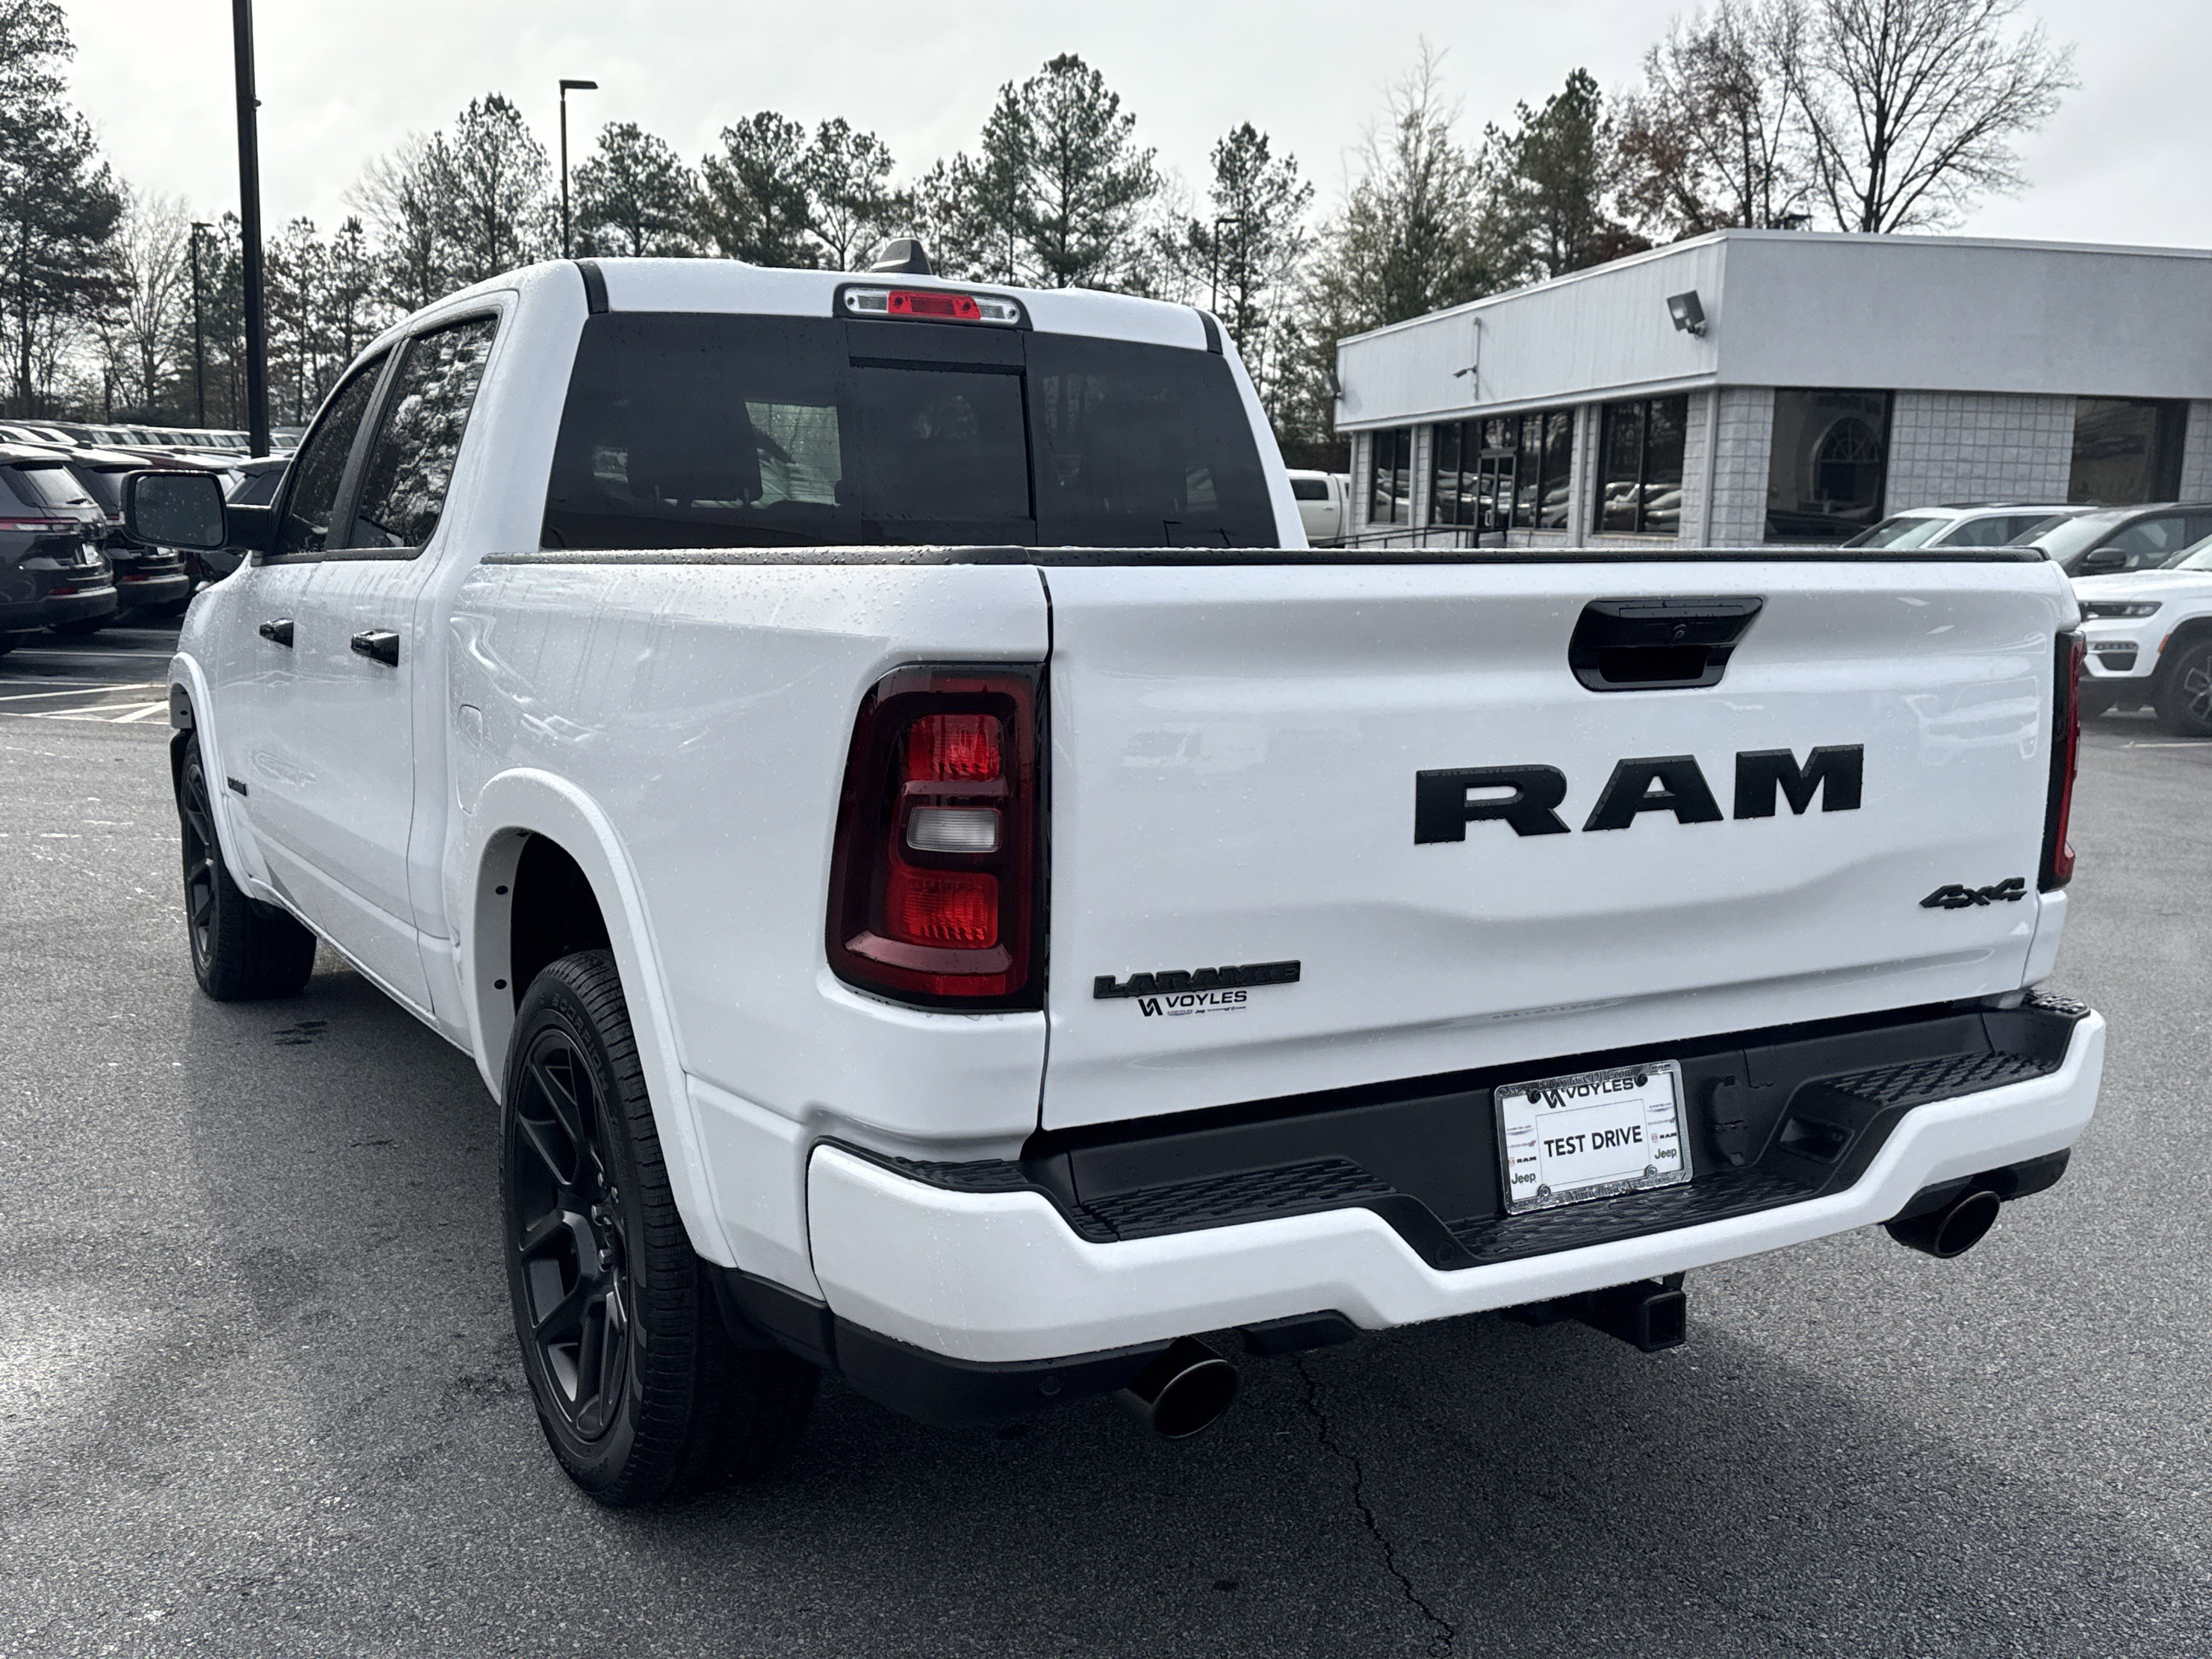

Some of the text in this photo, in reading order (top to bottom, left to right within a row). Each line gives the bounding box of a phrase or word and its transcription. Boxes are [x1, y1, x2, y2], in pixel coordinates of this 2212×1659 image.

[1414, 744, 1864, 845] RAM
[1919, 877, 2027, 910] 4x4
[1093, 960, 1301, 998] LARAMIE
[1165, 990, 1247, 1008] VOYLES
[1566, 1077, 1634, 1098] VOYLES
[1544, 1125, 1643, 1157] TEST DRIVE
[1654, 1148, 1677, 1159] Jeep
[1511, 1173, 1536, 1184] Jeep
